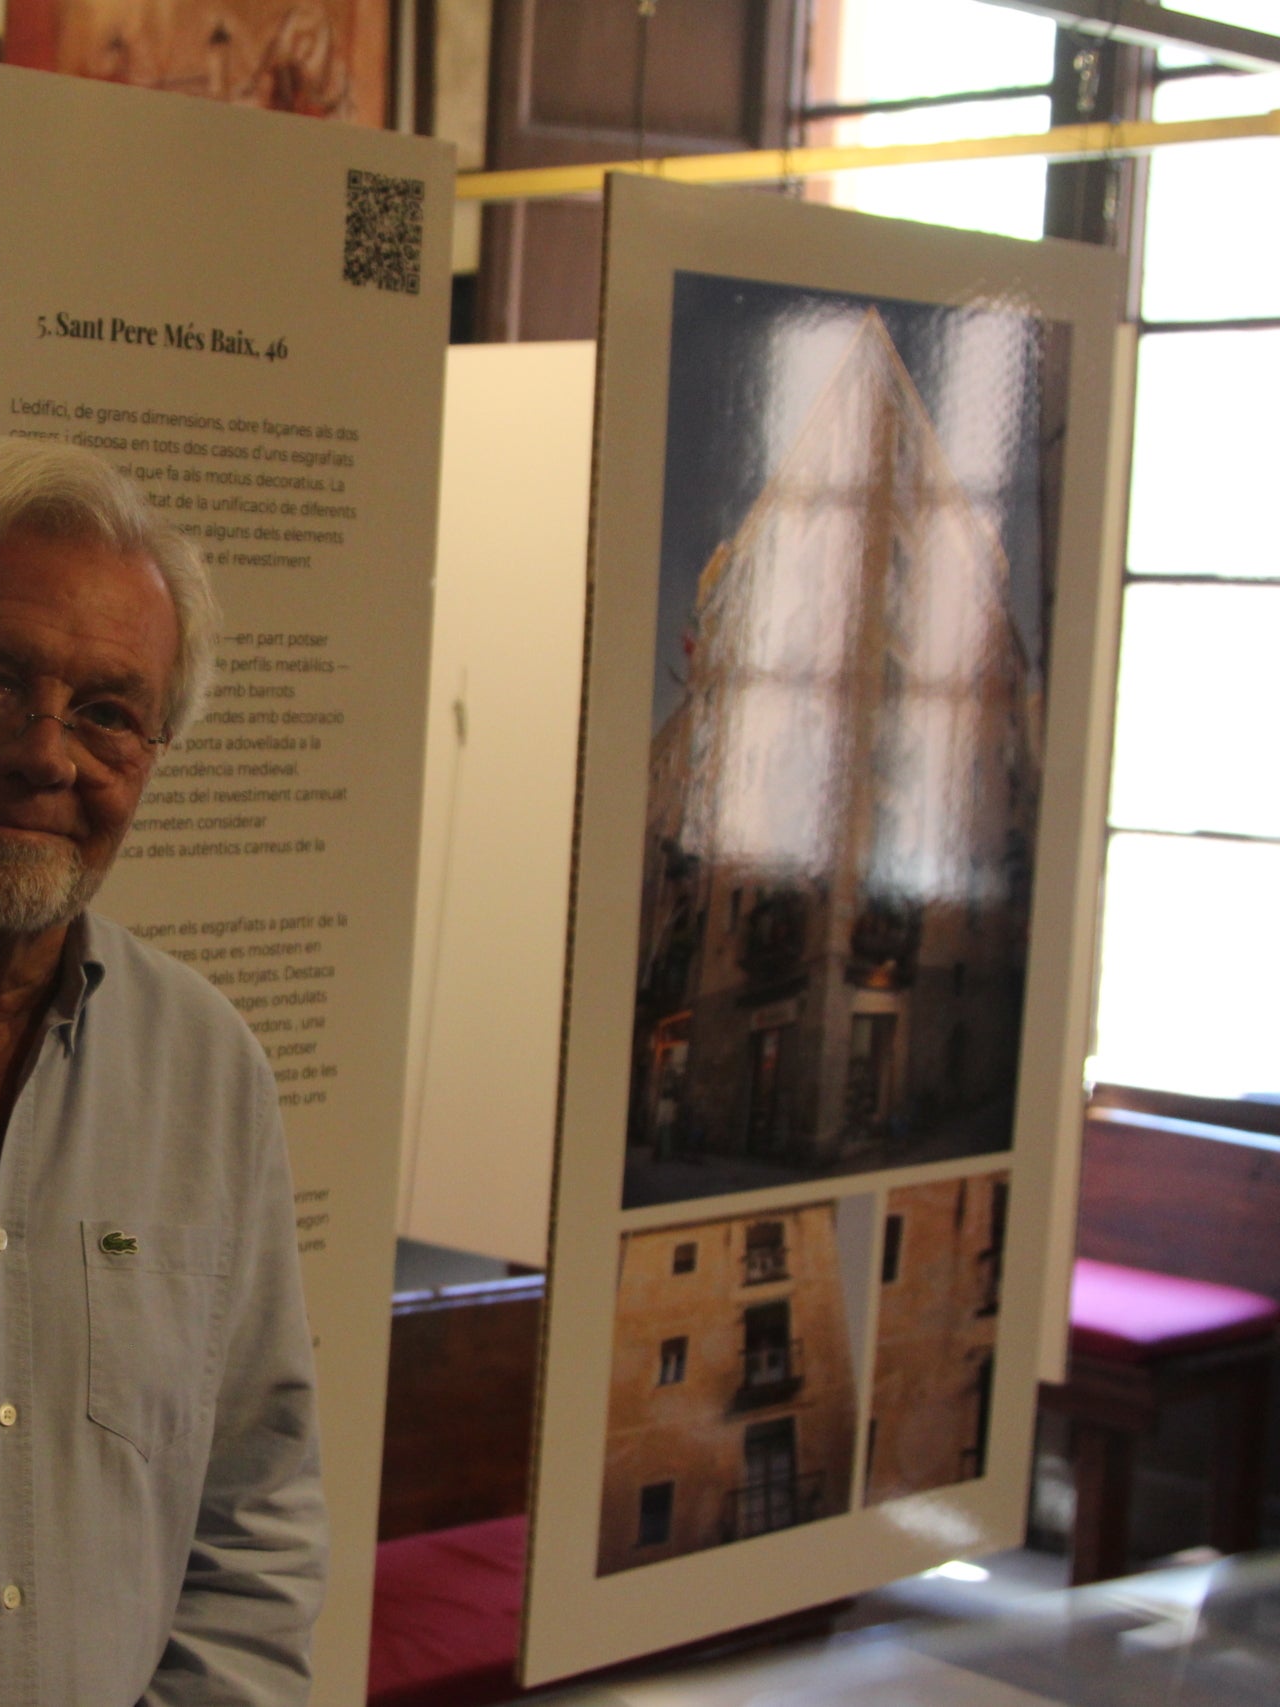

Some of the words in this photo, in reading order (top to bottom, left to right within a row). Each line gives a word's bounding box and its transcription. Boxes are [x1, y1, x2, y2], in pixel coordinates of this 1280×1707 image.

[37, 315, 52, 339] 5.
[55, 310, 104, 341] Sant
[110, 317, 158, 346] Pere
[163, 322, 205, 352] Més
[265, 336, 288, 362] 46
[10, 398, 71, 420] L'edifici,
[74, 402, 94, 419] de
[97, 408, 138, 424] grans
[141, 410, 225, 432] dimensions,
[228, 418, 260, 434] obre
[262, 419, 313, 438] façanes
[315, 424, 333, 440] als
[336, 428, 359, 442] dos
[71, 430, 128, 450] disposa
[131, 438, 151, 452] en
[154, 439, 181, 454] tots
[183, 441, 209, 456] dos
[211, 445, 250, 459] casos
[252, 444, 289, 461] d'uns
[291, 449, 355, 467] esgrafiats
[135, 465, 163, 482] que
[166, 464, 180, 480] fa
[183, 467, 201, 483] als
[206, 470, 252, 487] motius
[256, 472, 325, 492] decoratius.
[330, 477, 346, 493] La
[175, 493, 193, 509] de
[197, 496, 209, 511] la
[280, 500, 298, 515] de
[300, 501, 357, 519] diferents
[205, 521, 250, 541] alguns
[253, 524, 281, 541] dels
[283, 526, 344, 544] elements
[217, 550, 229, 565] el
[233, 553, 311, 568] revestiment
[257, 633, 284, 649] part
[287, 633, 328, 649] potser
[231, 656, 272, 674] perfils
[214, 684, 246, 698] amb
[249, 683, 296, 698] barrots
[248, 708, 278, 724] amb
[186, 736, 222, 753] porta
[226, 734, 296, 751] adovellada
[300, 738, 307, 751] a
[310, 734, 321, 751] la
[189, 786, 210, 804] del
[213, 787, 292, 803] revestiment
[295, 786, 348, 803] carreuat
[197, 814, 268, 831] considerar
[147, 842, 176, 858] dels
[244, 839, 294, 855] carreus
[295, 837, 312, 853] de
[314, 837, 326, 853] la
[180, 919, 198, 936] els
[201, 916, 266, 938] esgrafiats
[269, 917, 276, 930] a
[280, 914, 315, 934] partir
[318, 912, 334, 929] de
[337, 912, 348, 927] la
[201, 945, 227, 961] que
[229, 944, 245, 959] es
[248, 941, 303, 957] mostren
[305, 940, 321, 954] en
[283, 965, 336, 981] Destaca
[271, 990, 328, 1007] ondulats
[302, 1016, 326, 1030] una
[277, 1042, 318, 1060] potser
[302, 1064, 319, 1080] de
[321, 1062, 338, 1078] les
[303, 1090, 327, 1104] uns
